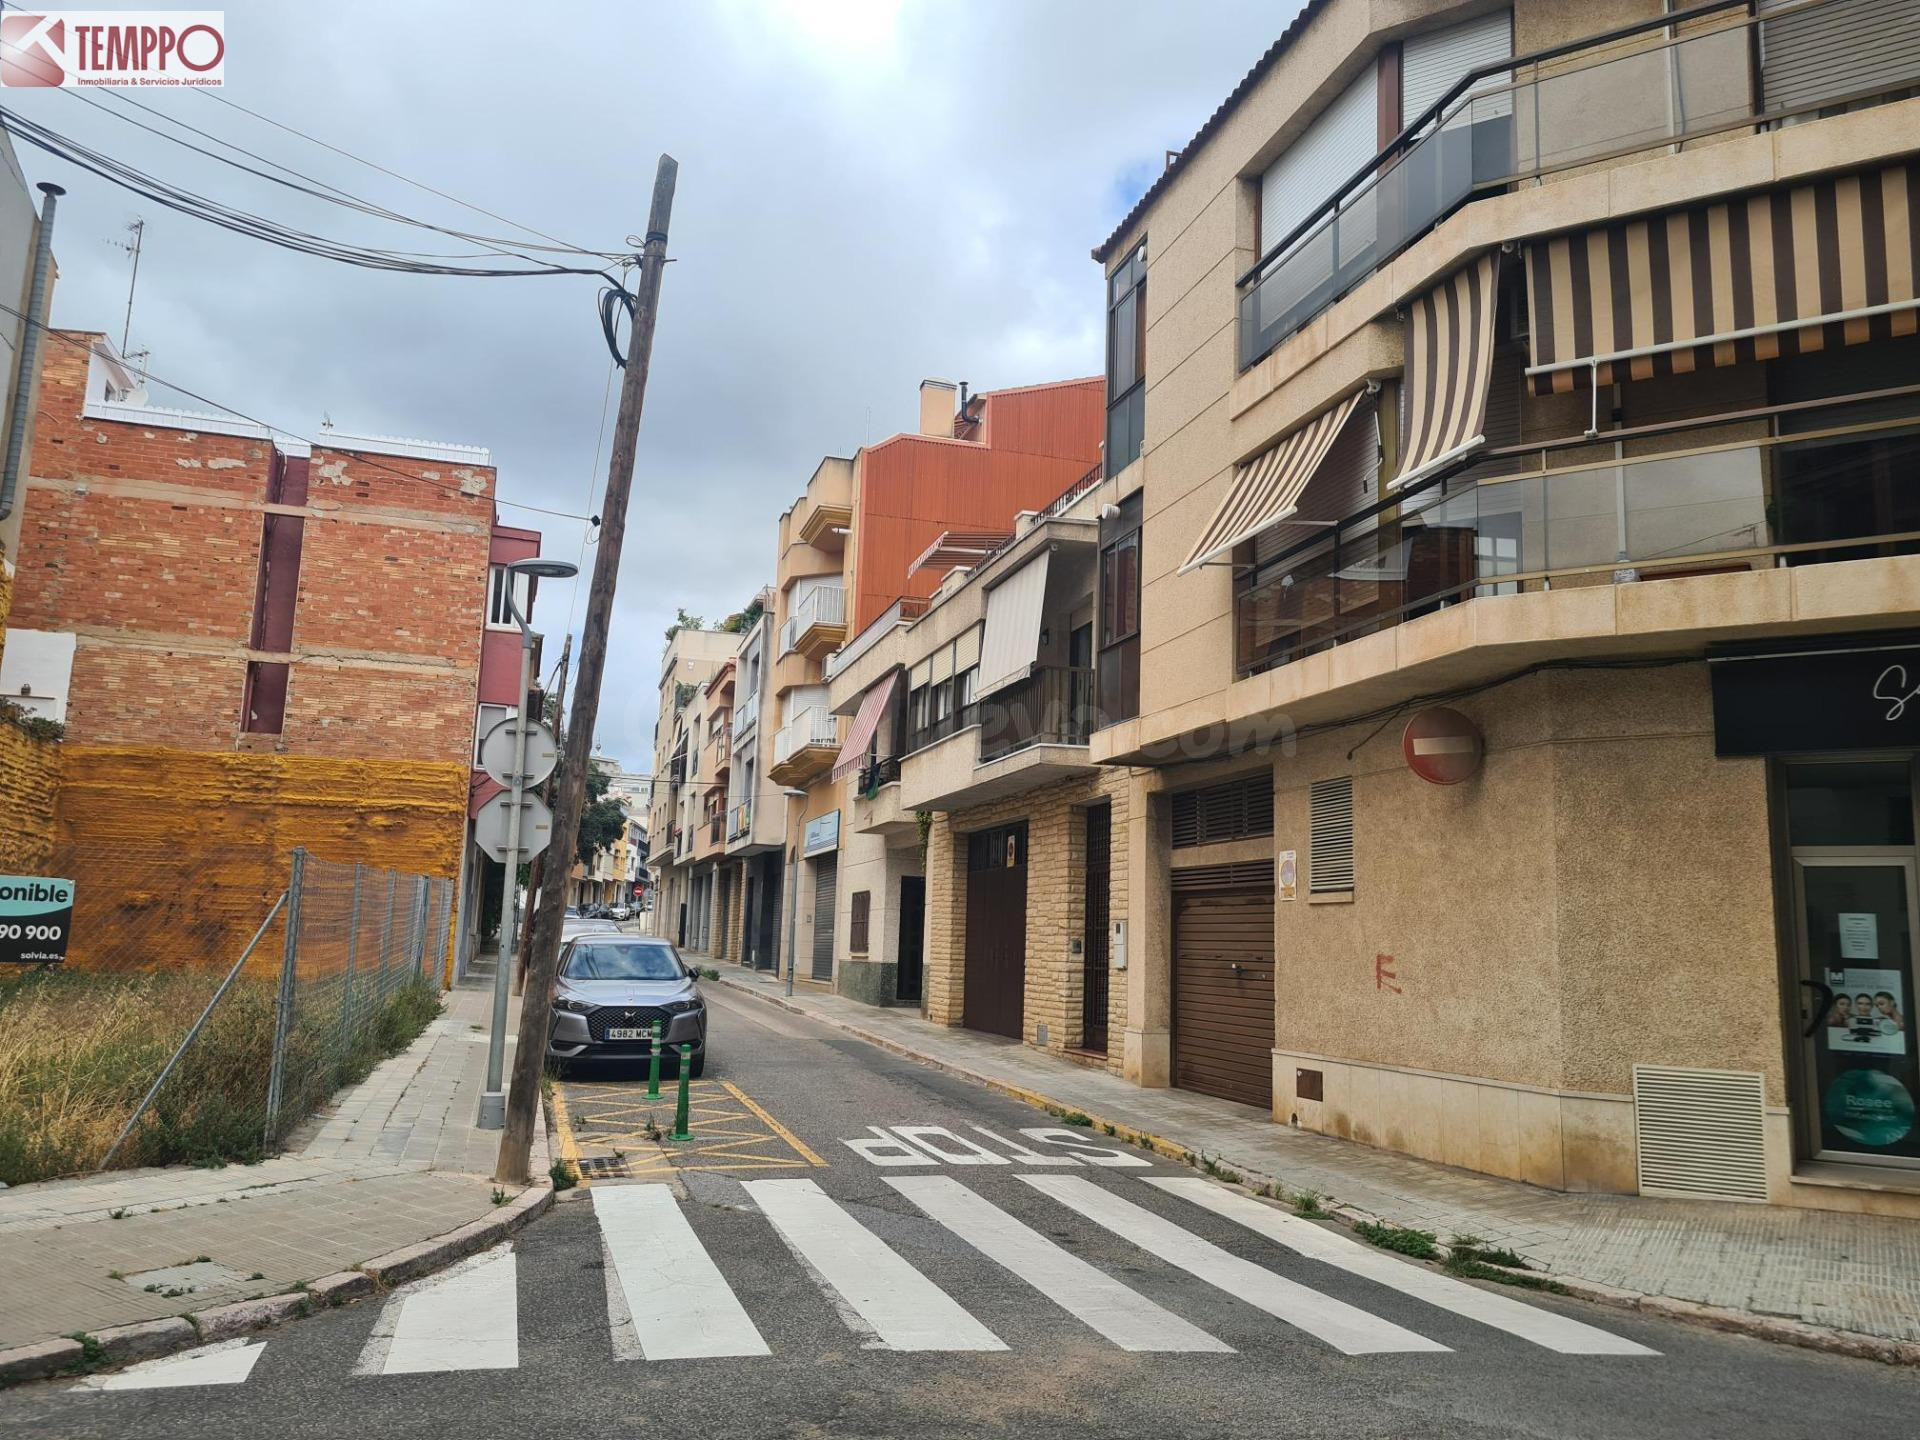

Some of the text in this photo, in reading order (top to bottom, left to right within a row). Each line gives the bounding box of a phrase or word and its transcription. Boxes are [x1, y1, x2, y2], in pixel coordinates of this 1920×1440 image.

[25, 926, 61, 940] 900
[20, 951, 59, 960] solvia.es
[611, 1029, 634, 1039] 4982
[837, 1123, 1155, 1168] STOP
